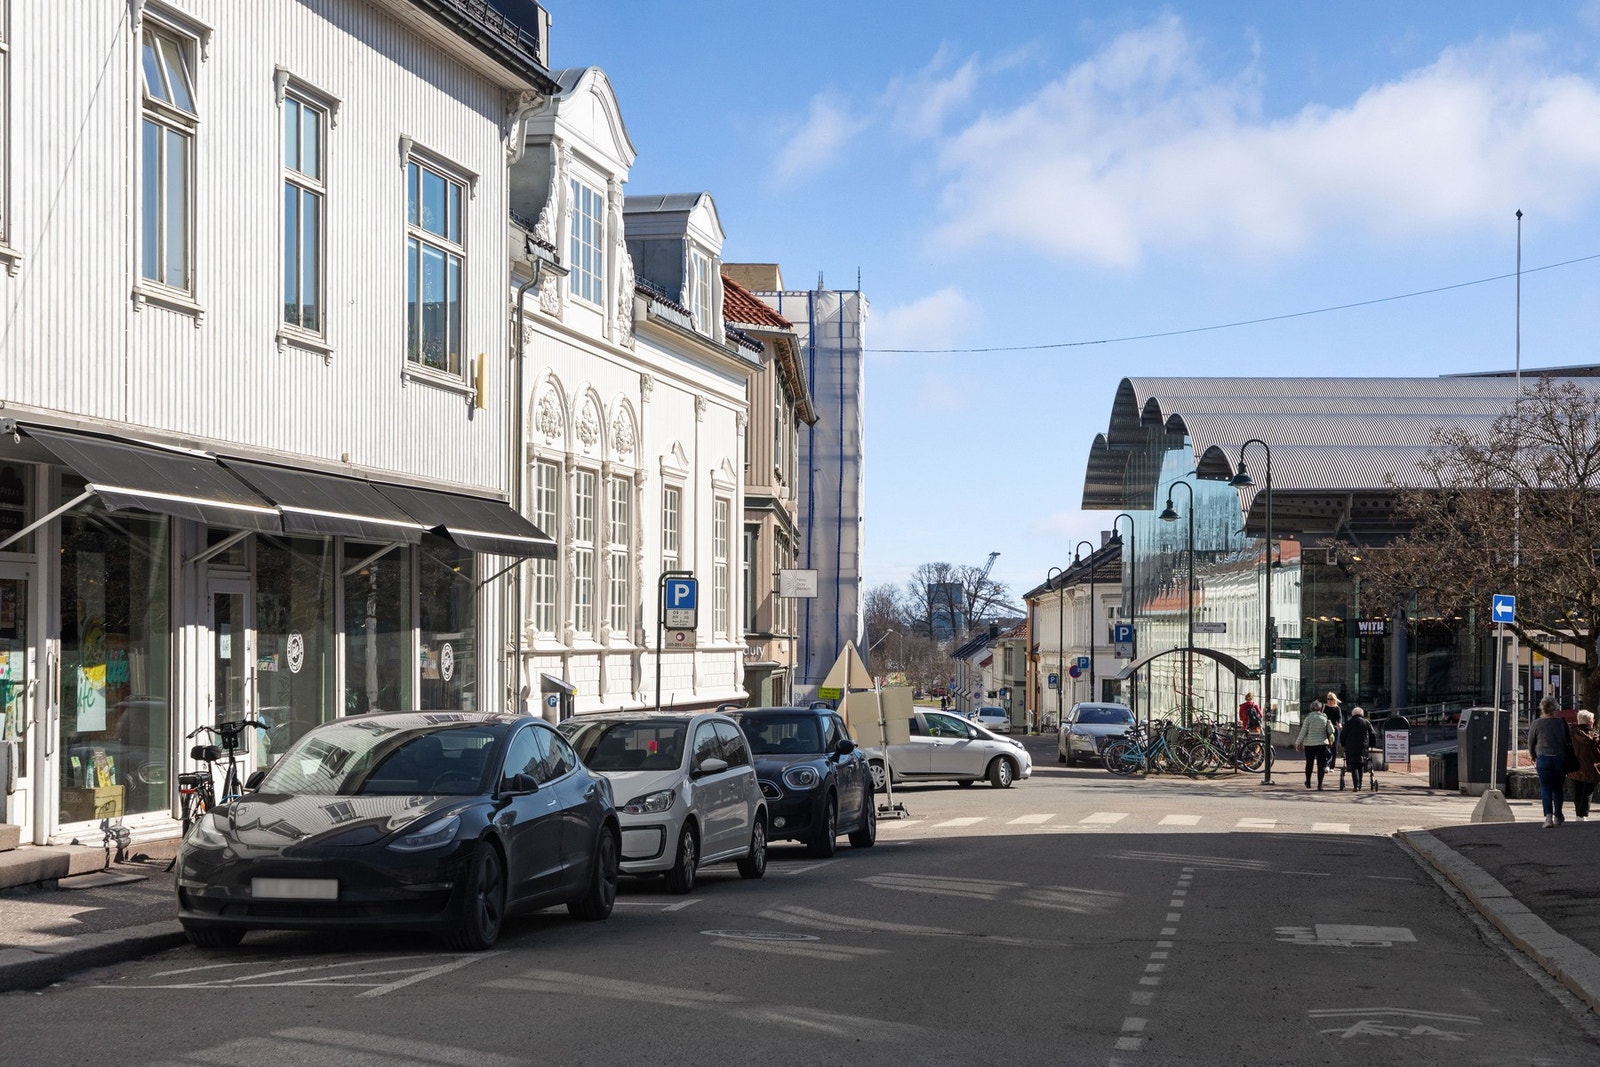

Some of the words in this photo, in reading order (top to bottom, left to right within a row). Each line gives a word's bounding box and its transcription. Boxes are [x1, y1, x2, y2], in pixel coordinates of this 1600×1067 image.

[674, 583, 690, 606] P
[1358, 621, 1384, 631] WITH
[1119, 626, 1130, 641] P
[744, 644, 766, 659] auty
[1079, 657, 1087, 667] P
[550, 696, 557, 706] P
